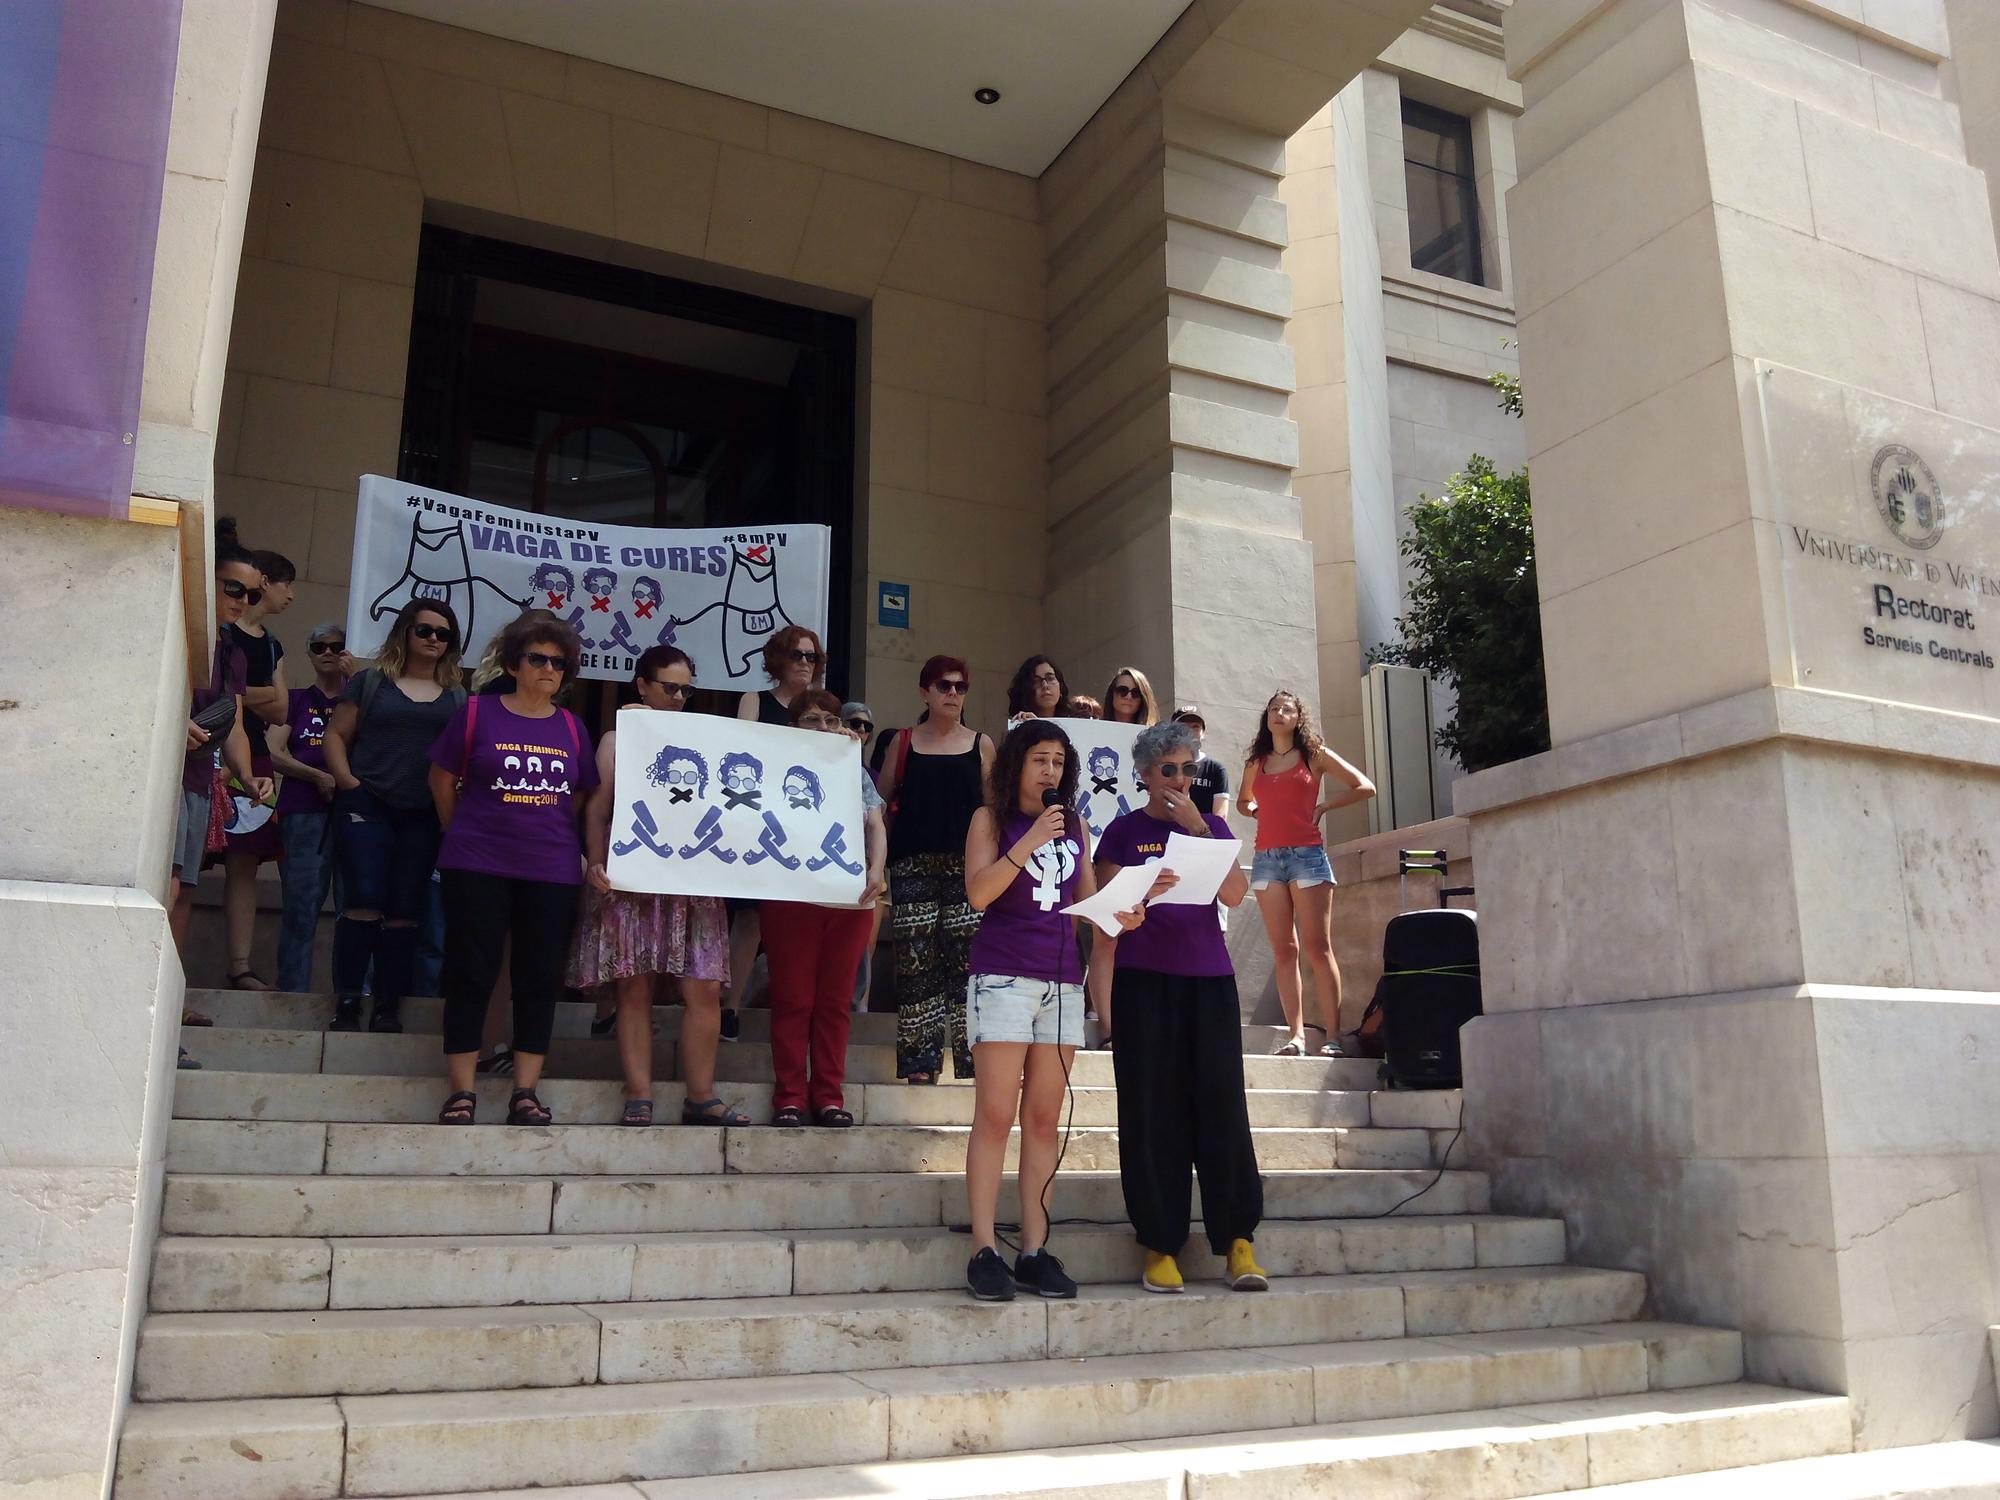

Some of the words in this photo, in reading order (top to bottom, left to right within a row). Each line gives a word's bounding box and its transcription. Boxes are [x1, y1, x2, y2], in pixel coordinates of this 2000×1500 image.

[406, 495, 599, 542] #VagaFeministaPV
[722, 532, 787, 547] #8mPV
[469, 523, 562, 560] VAGA
[570, 542, 613, 564] DE
[620, 545, 727, 577] CURES
[421, 584, 442, 598] 8M
[1873, 584, 1975, 630] Rectorat
[750, 615, 769, 630] 8M
[1863, 627, 1923, 655] Serveis
[1929, 640, 1994, 669] Centrals
[603, 655, 618, 670] EL
[495, 743, 521, 751] VAGA
[523, 744, 568, 758] FEMINISTA
[1137, 843, 1162, 853] VAGA
